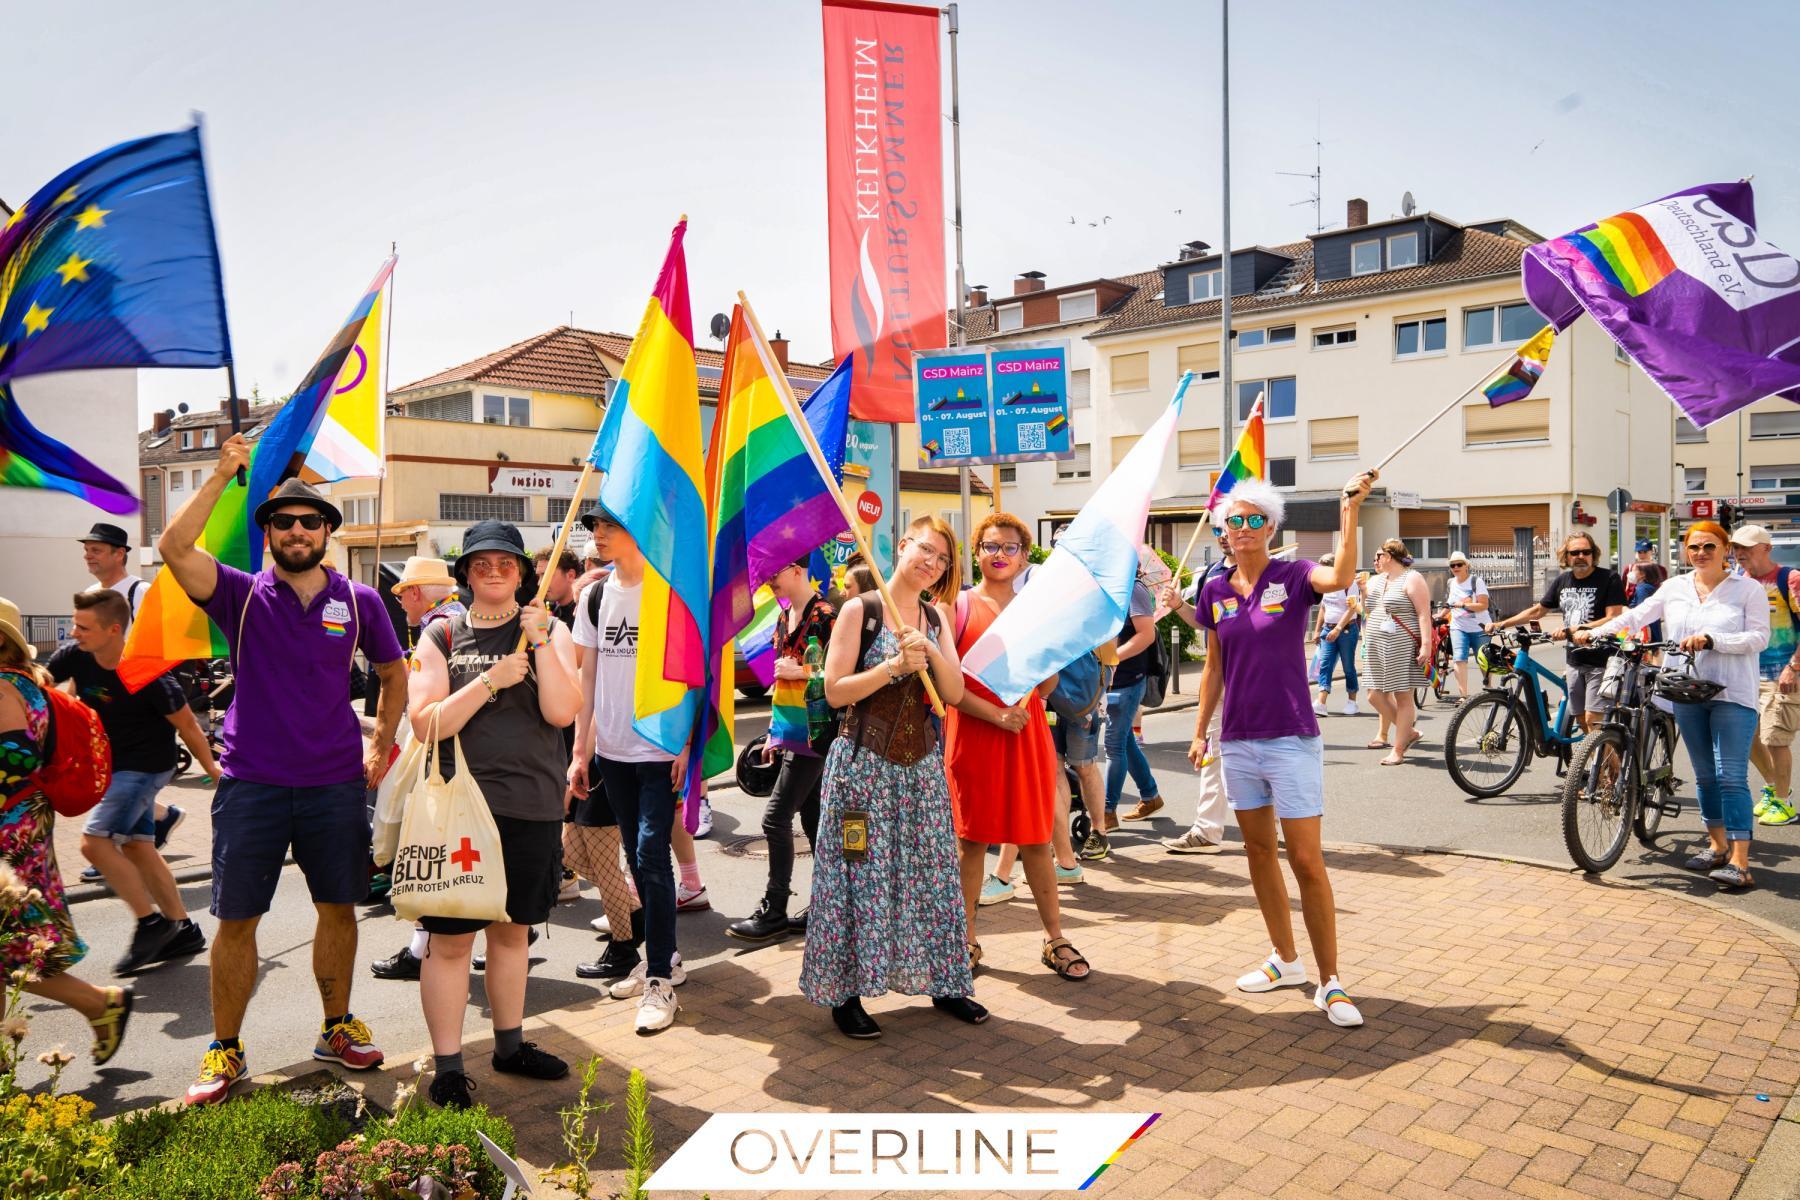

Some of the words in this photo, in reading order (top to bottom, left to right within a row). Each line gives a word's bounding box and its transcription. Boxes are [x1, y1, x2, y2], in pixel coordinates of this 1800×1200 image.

[1659, 200, 1731, 269] Deutschland
[1718, 274, 1746, 297] e.V.
[923, 368, 947, 379] CSD
[950, 366, 983, 377] Mainz
[997, 362, 1022, 373] CSD
[1025, 360, 1060, 371] Mainz
[955, 411, 987, 420] August
[1030, 406, 1063, 415] August
[846, 433, 858, 448] eo
[859, 500, 880, 517] NEU!
[1263, 588, 1286, 600] CSD
[325, 605, 349, 617] CSD
[398, 844, 447, 862] SPENDE
[393, 858, 447, 885] BLUT
[391, 883, 414, 897] BEIM
[417, 880, 450, 893] ROTEN
[453, 874, 485, 887] KREUZ
